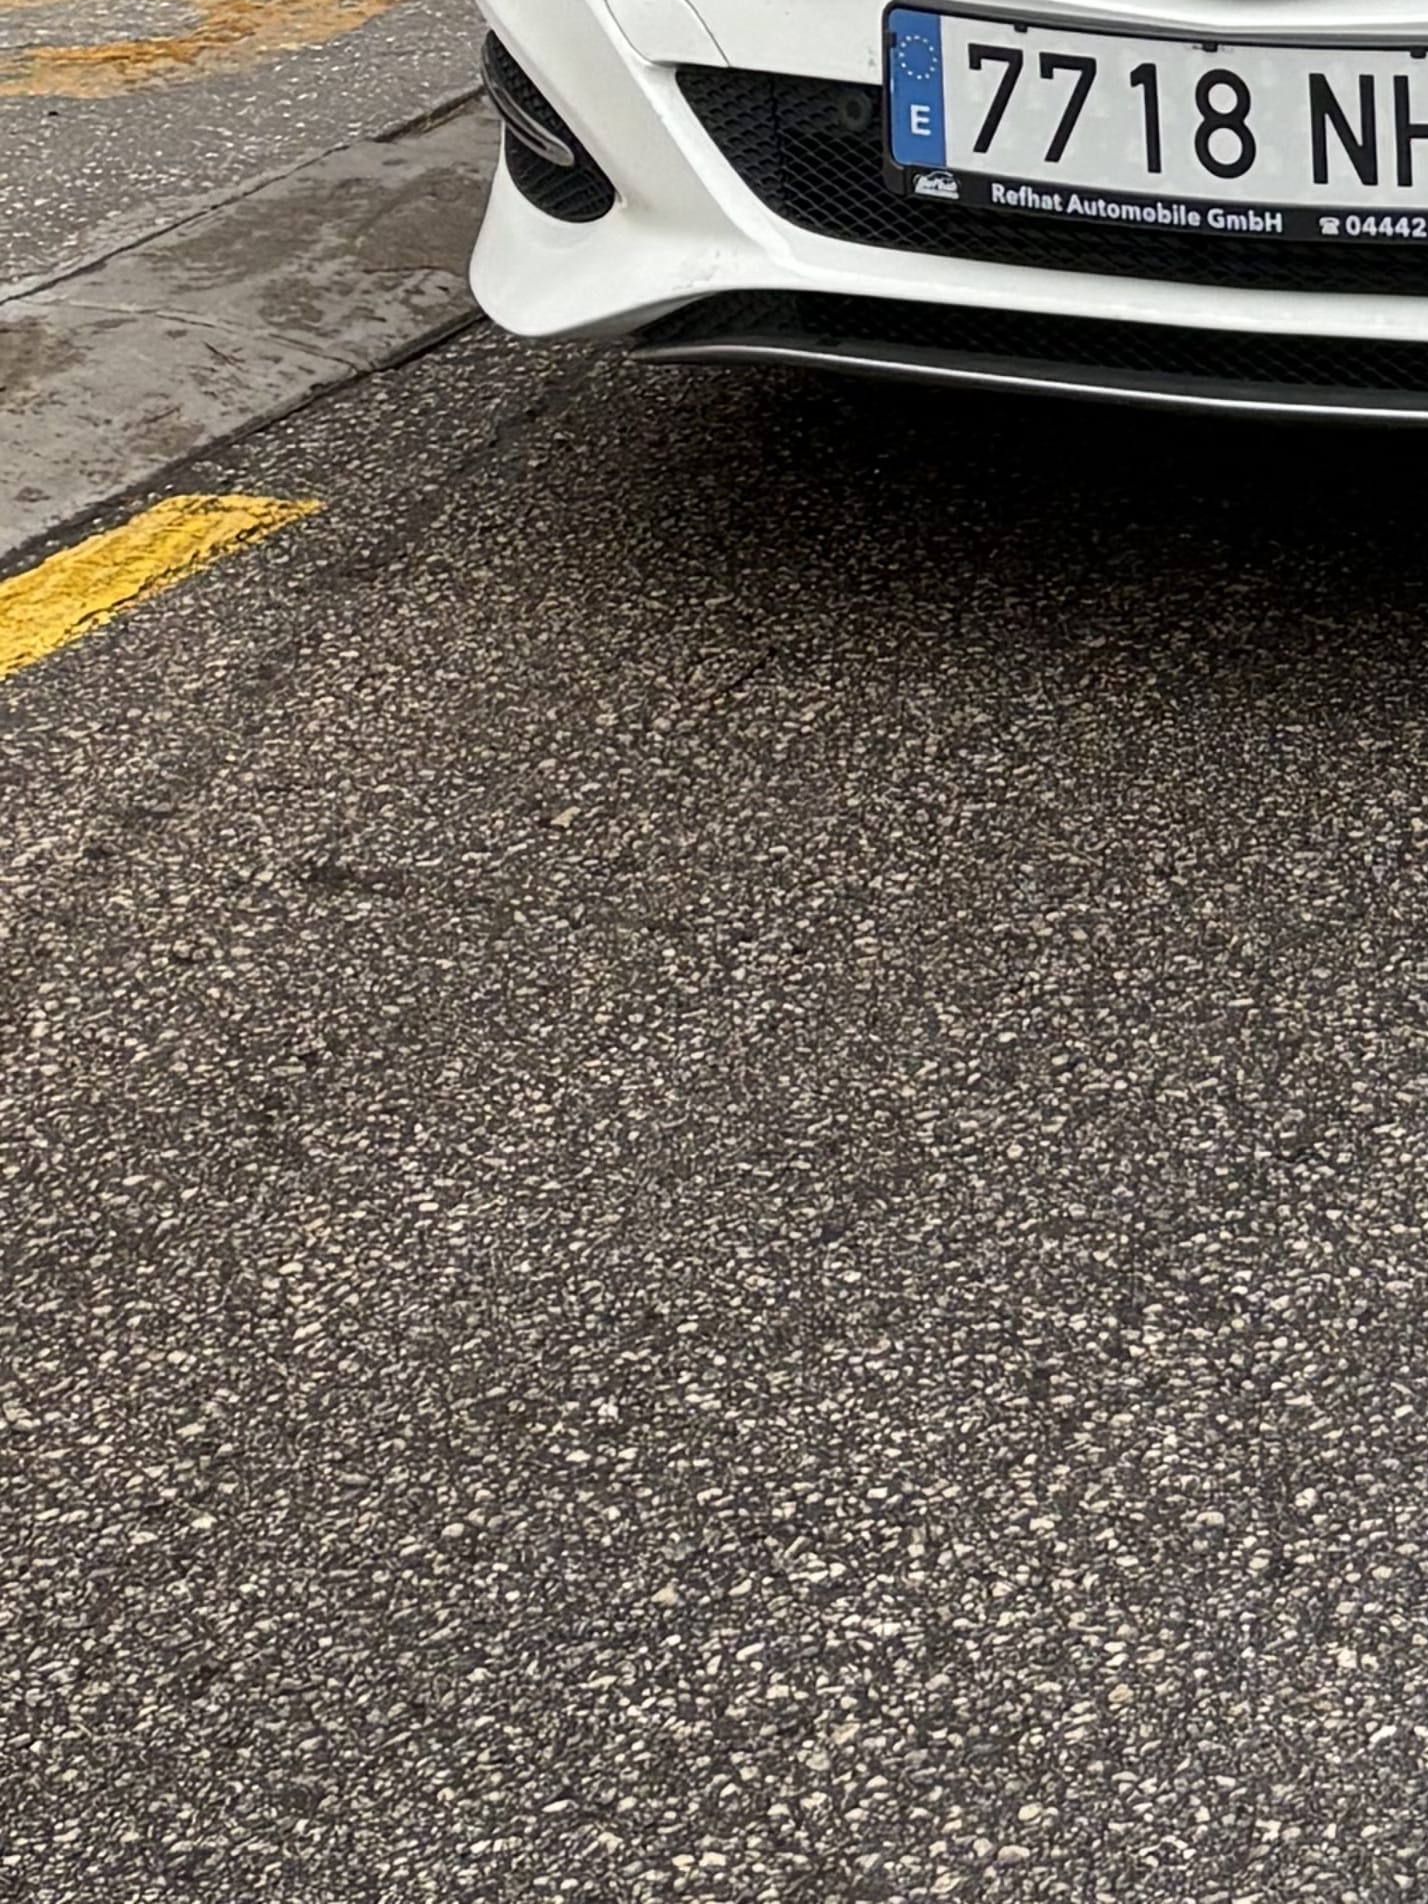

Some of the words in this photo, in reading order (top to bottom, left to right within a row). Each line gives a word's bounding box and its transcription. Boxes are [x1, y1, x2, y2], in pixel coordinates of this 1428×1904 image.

[910, 104, 932, 135] E
[967, 42, 1258, 179] 7718
[991, 182, 1064, 212] Refhat
[1066, 194, 1201, 227] Automobile
[1207, 208, 1284, 233] GmbH
[1345, 215, 1428, 238] 04442
